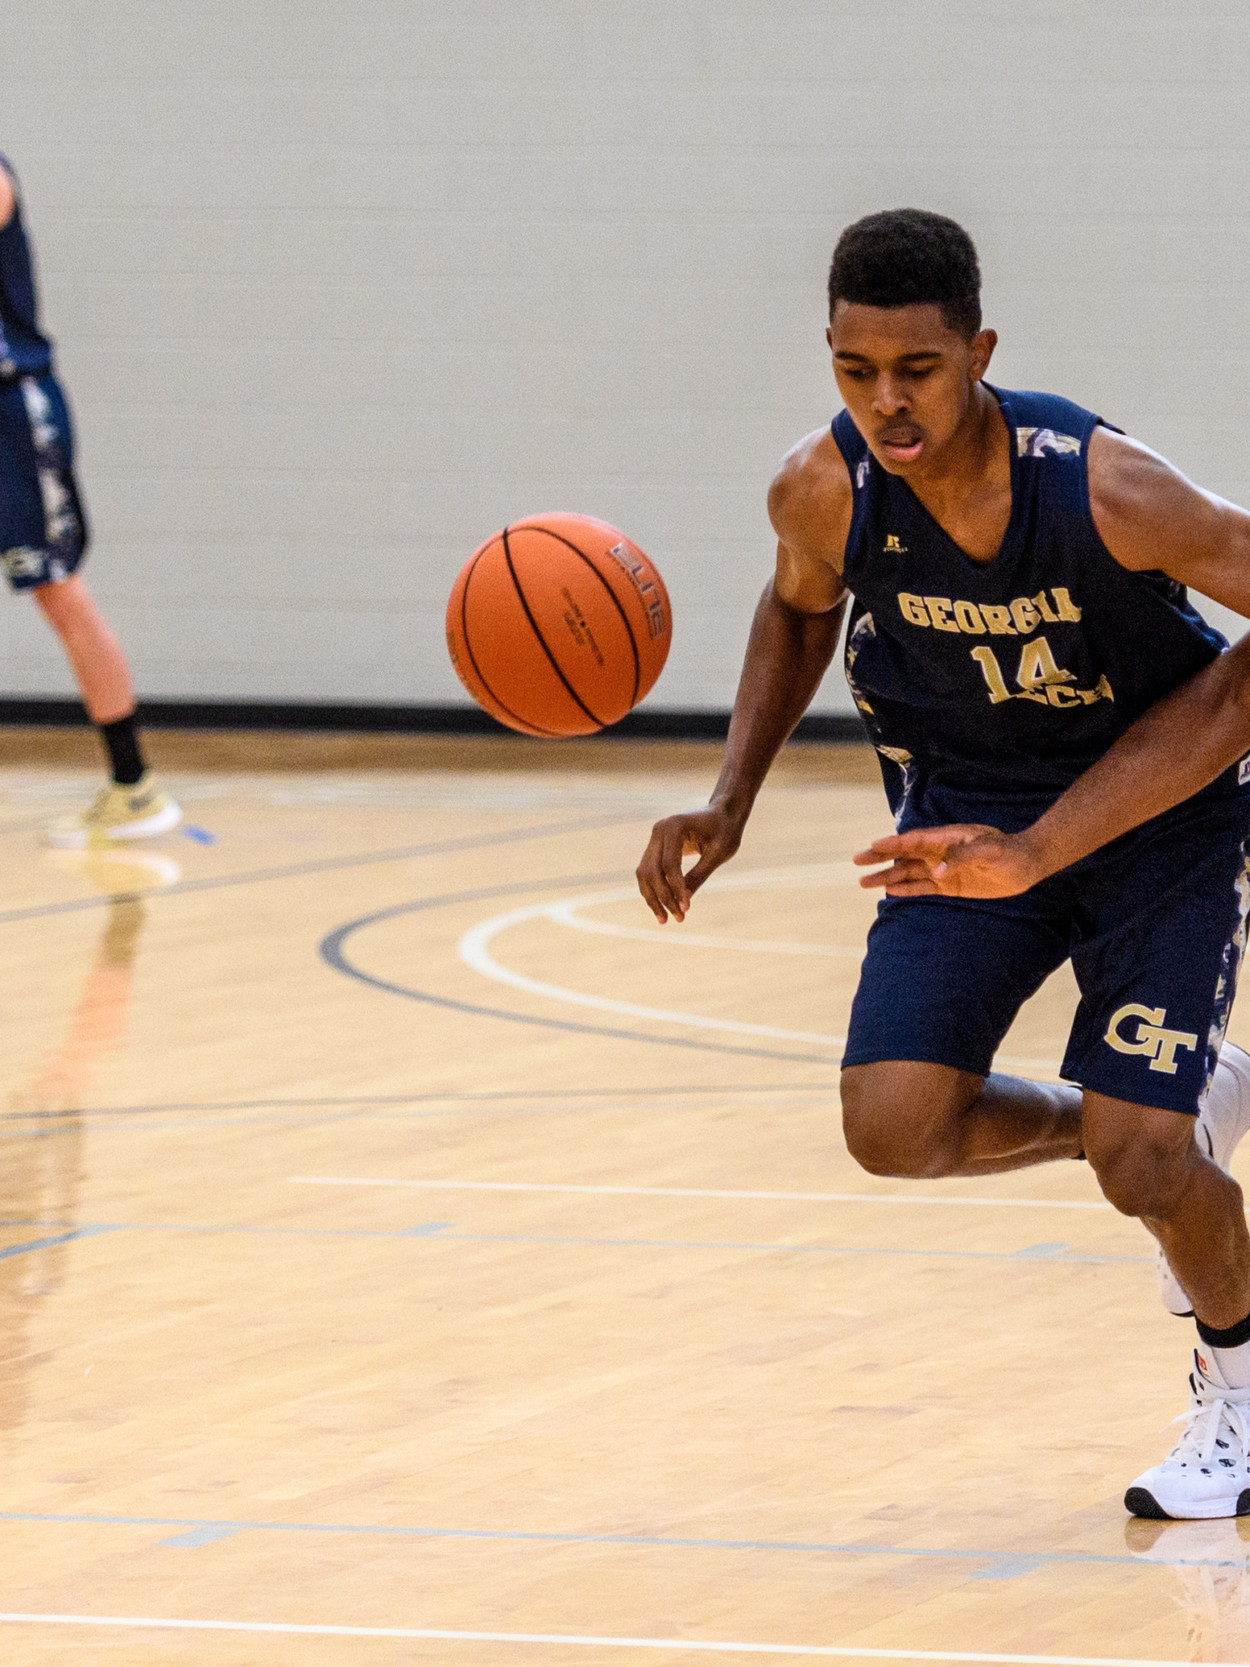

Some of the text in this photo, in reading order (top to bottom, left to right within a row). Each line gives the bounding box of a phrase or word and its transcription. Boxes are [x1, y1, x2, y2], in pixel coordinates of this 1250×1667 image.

[898, 587, 1082, 635] GEORGIA
[970, 636, 1077, 704] 14
[1103, 1003, 1198, 1074] GT
